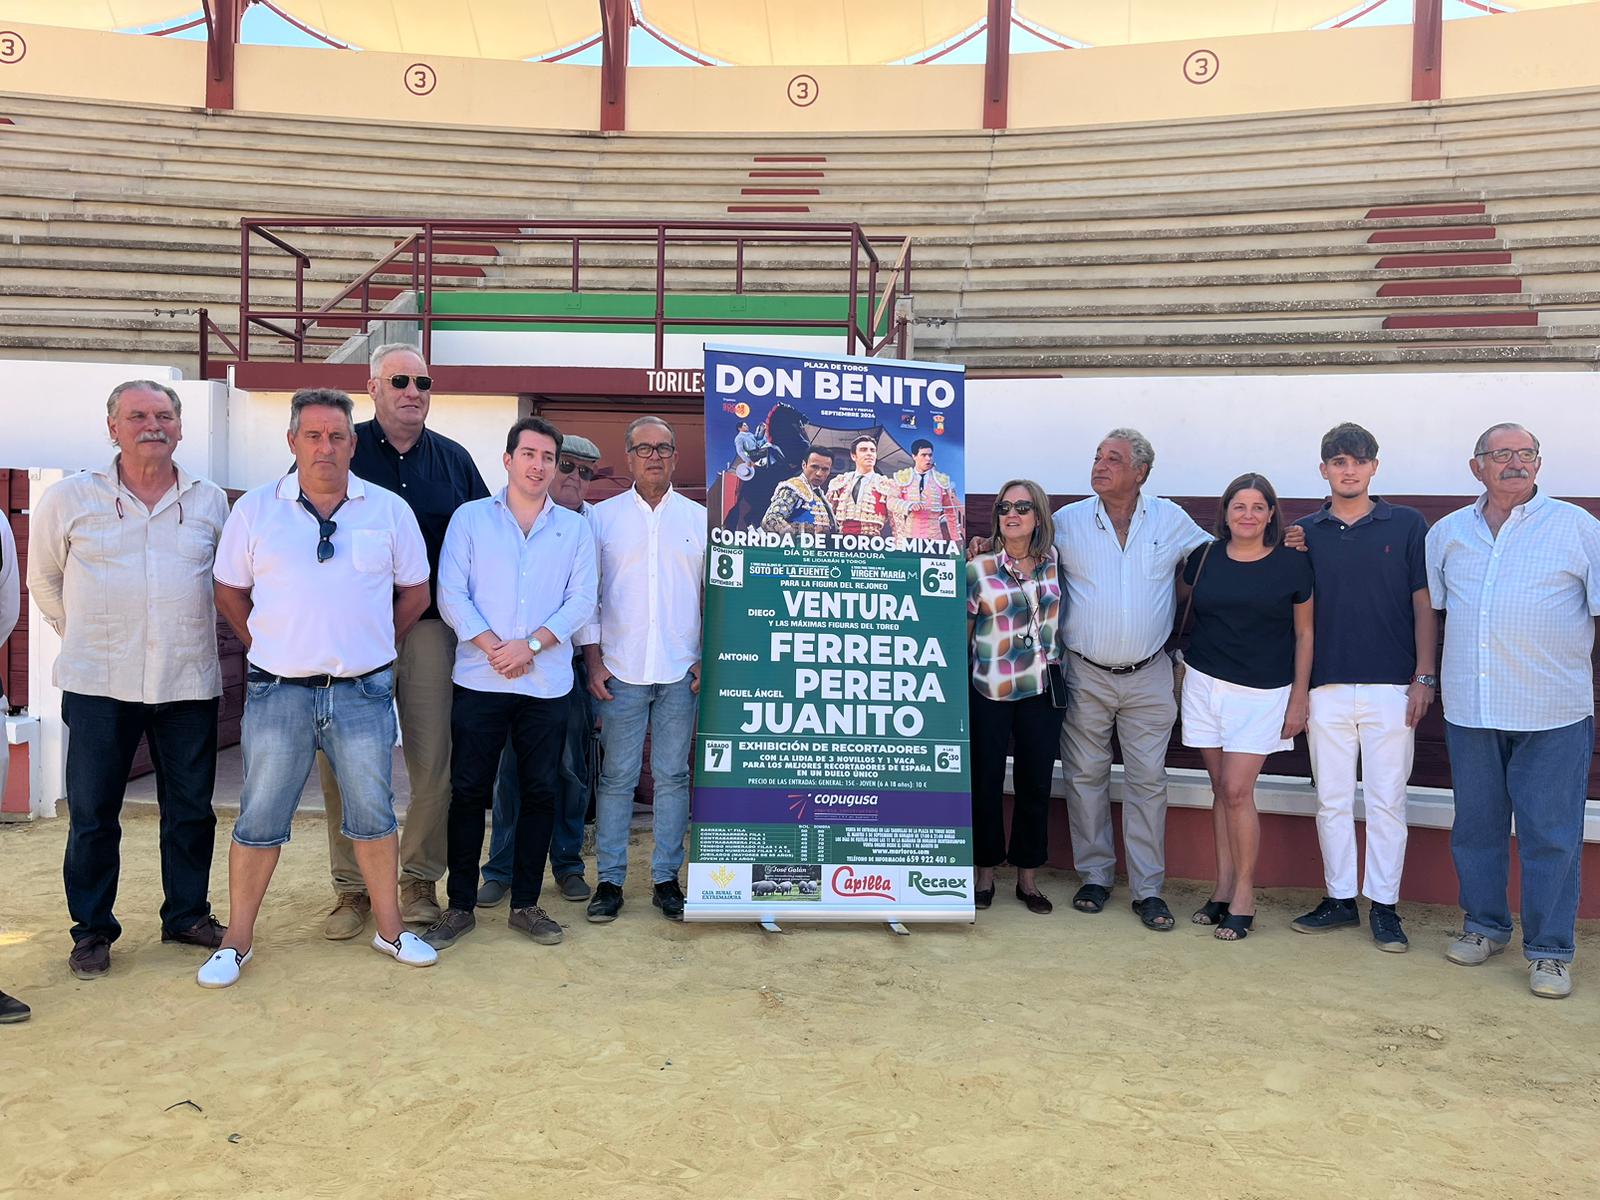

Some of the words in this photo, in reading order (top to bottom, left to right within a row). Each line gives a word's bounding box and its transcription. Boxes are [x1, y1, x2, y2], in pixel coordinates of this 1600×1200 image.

[2, 39, 14, 56] 3
[1195, 58, 1207, 75] 3
[415, 71, 425, 88] 3
[797, 83, 808, 99] 3
[716, 364, 801, 398] DON
[815, 371, 955, 408] BENITO
[711, 527, 795, 548] CORRIDA
[800, 533, 826, 548] DE
[831, 535, 897, 551] TOROS
[902, 538, 960, 555] MIXTA
[817, 551, 885, 559] EXTREMADURA
[717, 554, 733, 579] 8
[750, 566, 772, 574] SOTO
[773, 566, 784, 574] DE
[786, 567, 798, 575] LA
[798, 567, 830, 576] FUENTE
[851, 569, 879, 578] VIRGEN
[881, 570, 906, 578] MARÍA
[855, 582, 888, 590] REJONEO
[783, 591, 919, 621] VENTURA
[718, 652, 758, 662] ANTONIO
[771, 632, 947, 667] FERRERA
[720, 689, 752, 697] MIGUEL
[754, 688, 784, 698] ÁNGEL
[796, 668, 946, 702] PERERA
[740, 702, 924, 736] JUANITO
[738, 740, 808, 751] EXHIBICIÓN
[812, 743, 828, 751] DE
[832, 744, 928, 754] RECORTADORES
[711, 748, 724, 768] 7
[824, 763, 886, 771] RECORTADORES
[901, 764, 932, 772] ESPAÑA
[853, 769, 878, 778] ÚNICO
[814, 794, 878, 806] copugusa
[832, 866, 896, 901] Capilla
[908, 871, 967, 898] Recaex
